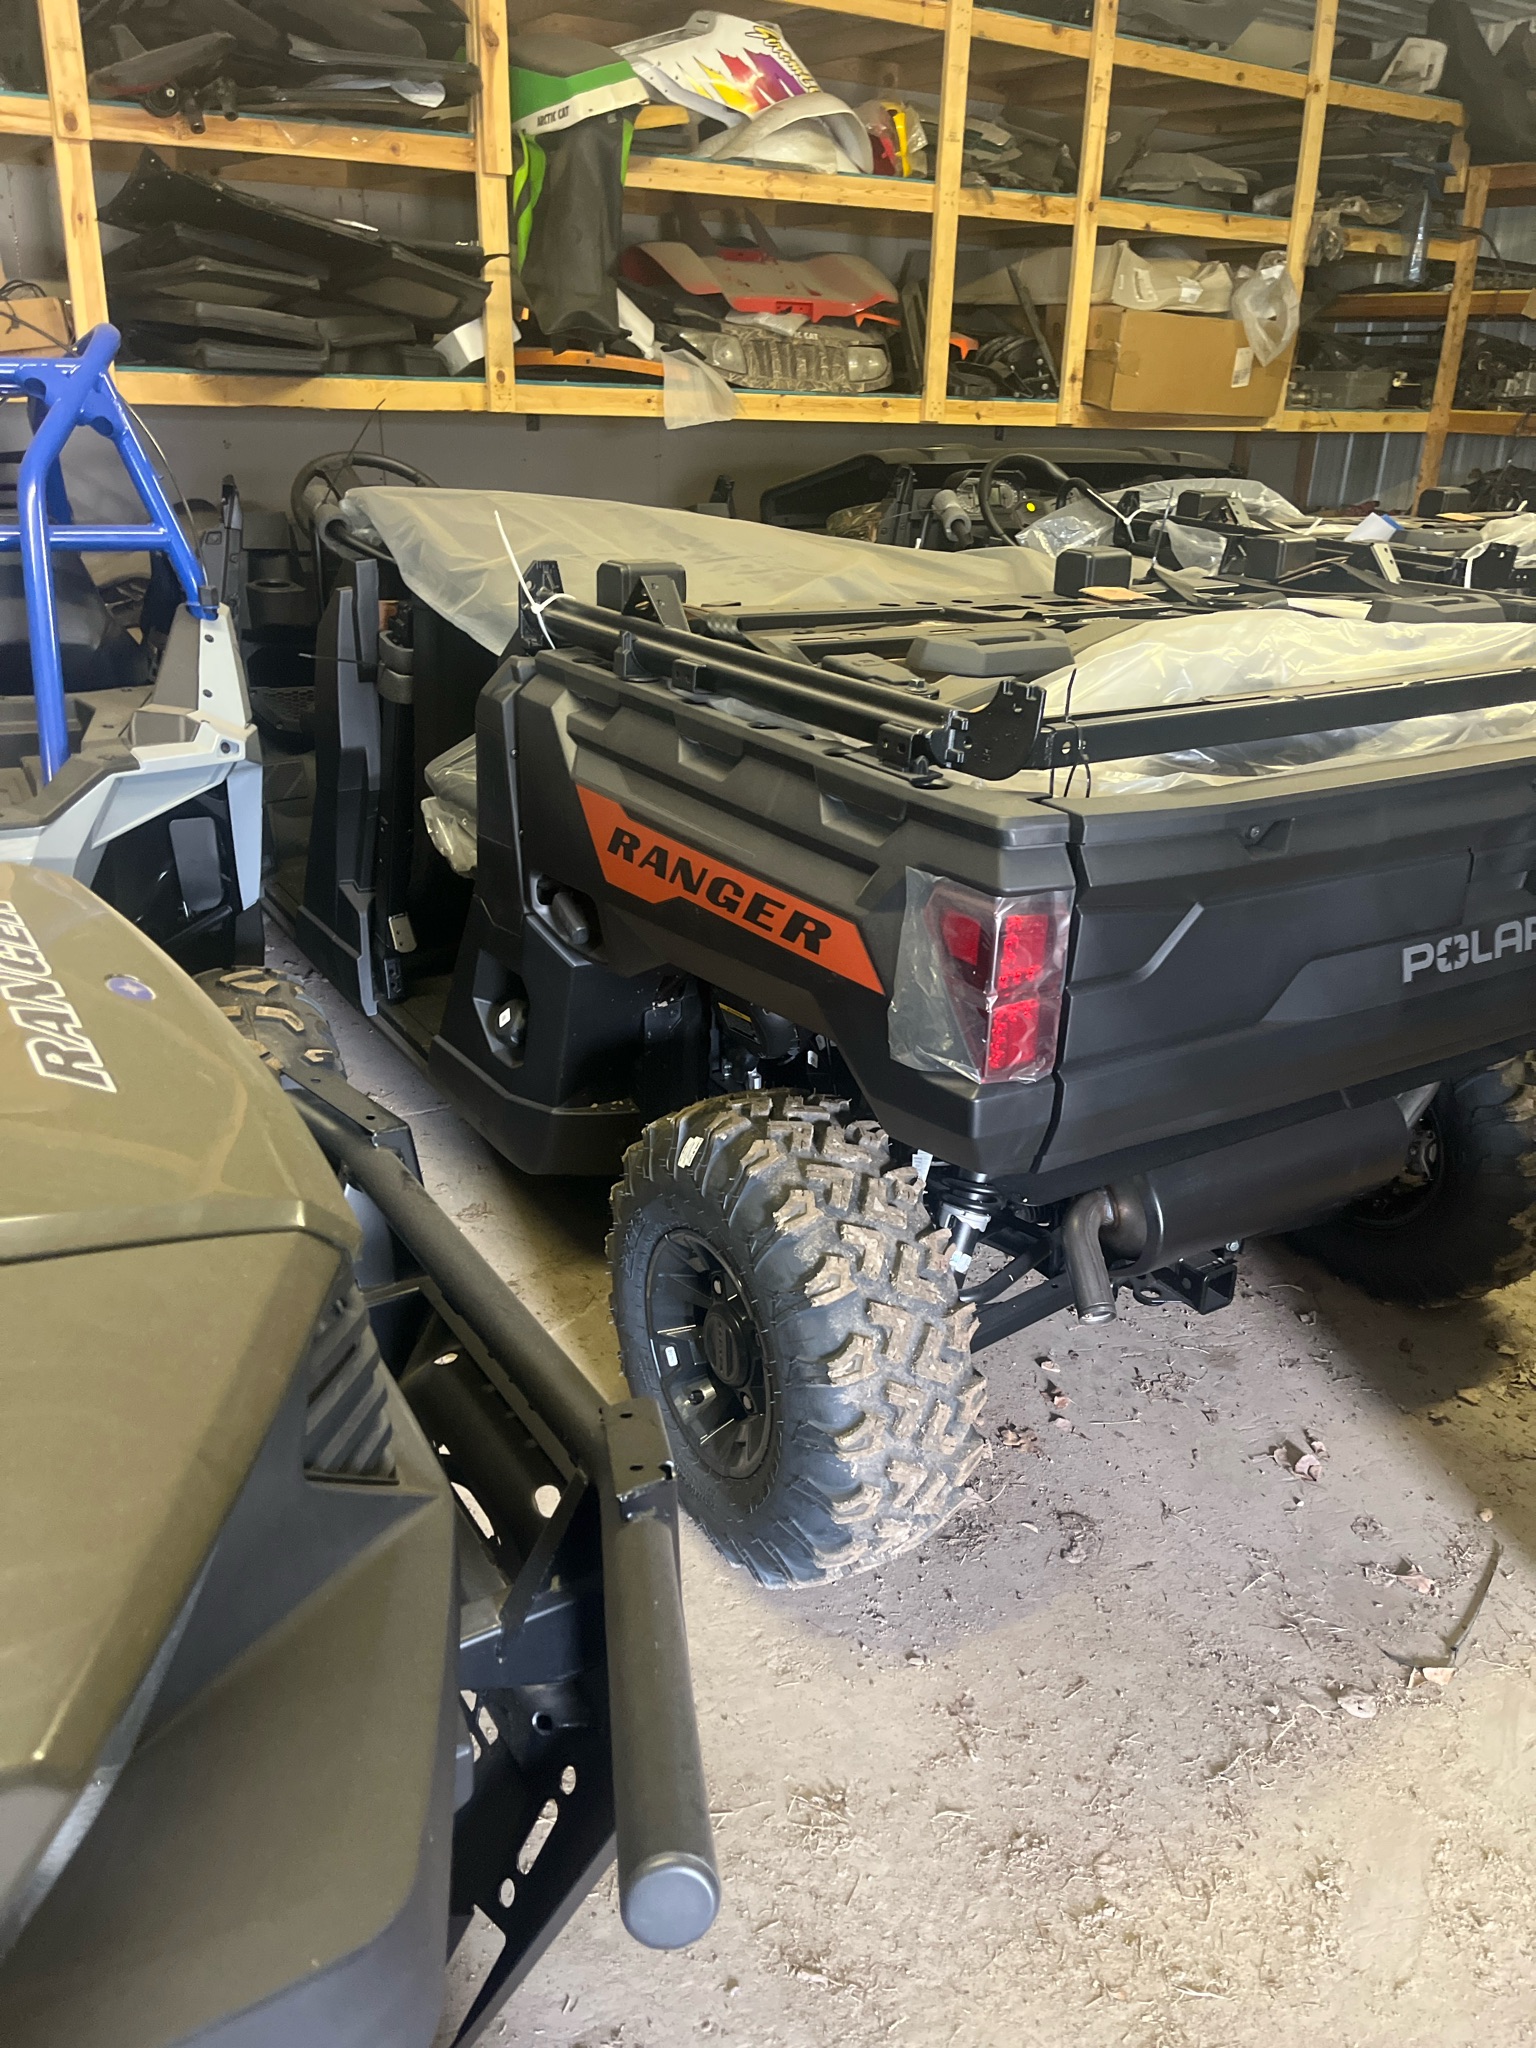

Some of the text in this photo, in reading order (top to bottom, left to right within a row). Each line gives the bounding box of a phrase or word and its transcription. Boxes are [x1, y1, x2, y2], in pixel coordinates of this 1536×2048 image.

[537, 105, 569, 127] ARCTIC CAT
[607, 826, 832, 956] RANGER
